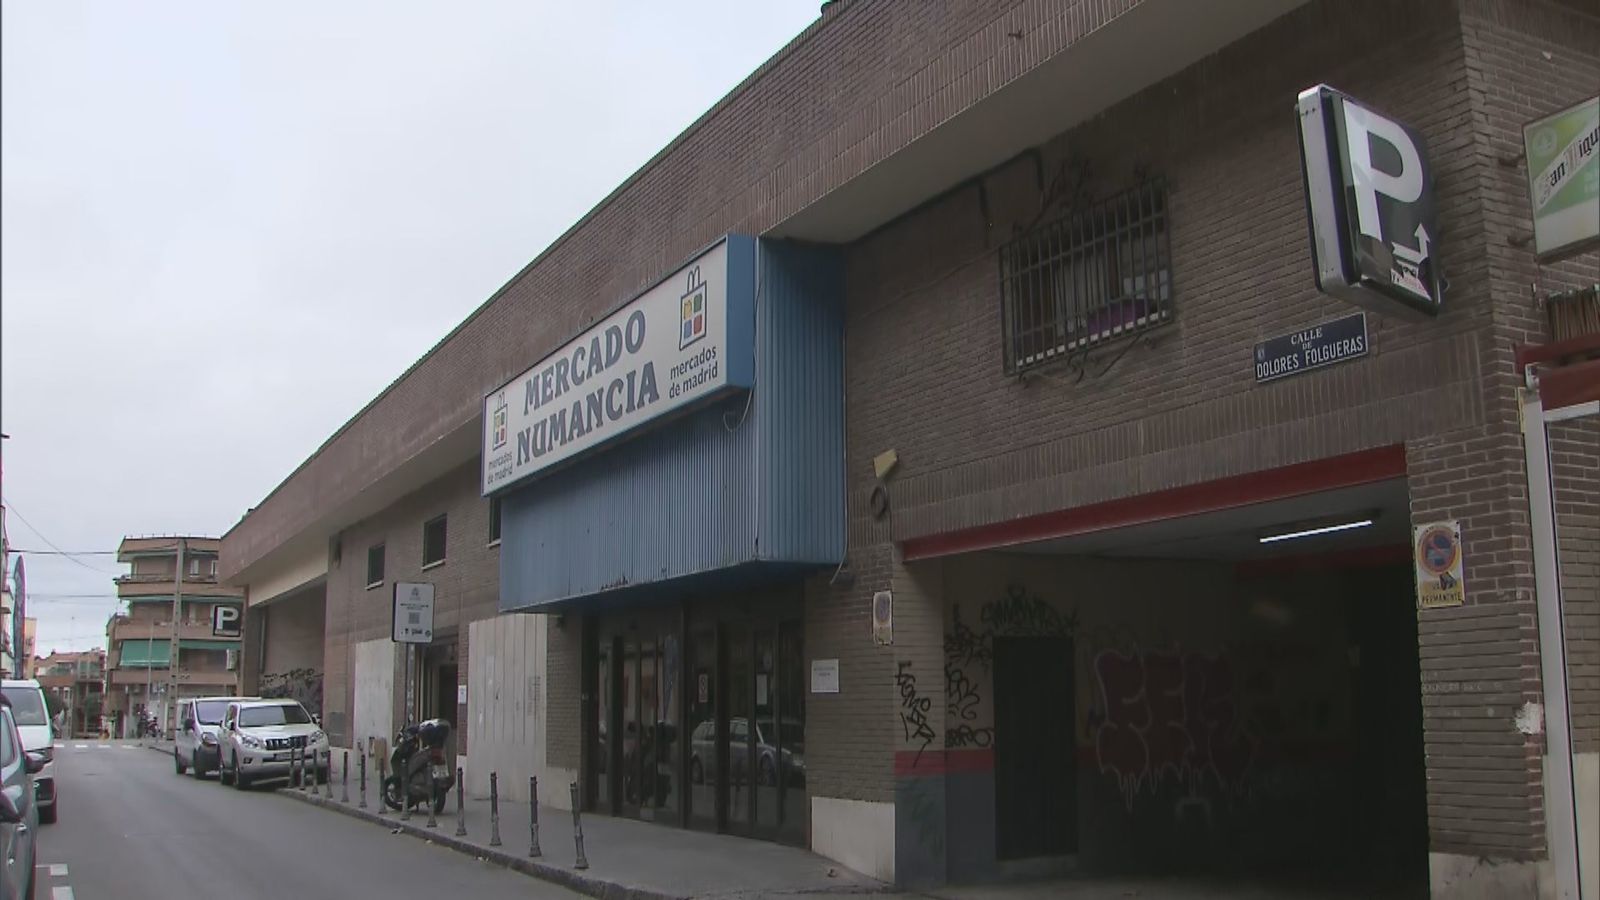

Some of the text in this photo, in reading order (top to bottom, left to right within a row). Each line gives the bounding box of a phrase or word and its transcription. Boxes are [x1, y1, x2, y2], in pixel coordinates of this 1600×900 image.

[1342, 97, 1424, 243] P
[1290, 327, 1323, 345] CALLE
[1302, 341, 1312, 350] DE
[523, 309, 647, 417] MERCADO
[670, 345, 717, 380] mercados
[1256, 336, 1363, 378] DOLORES FOLGUERAS
[669, 362, 719, 399] de madrid
[516, 360, 660, 467] NUMANCIA
[217, 606, 240, 630] P
